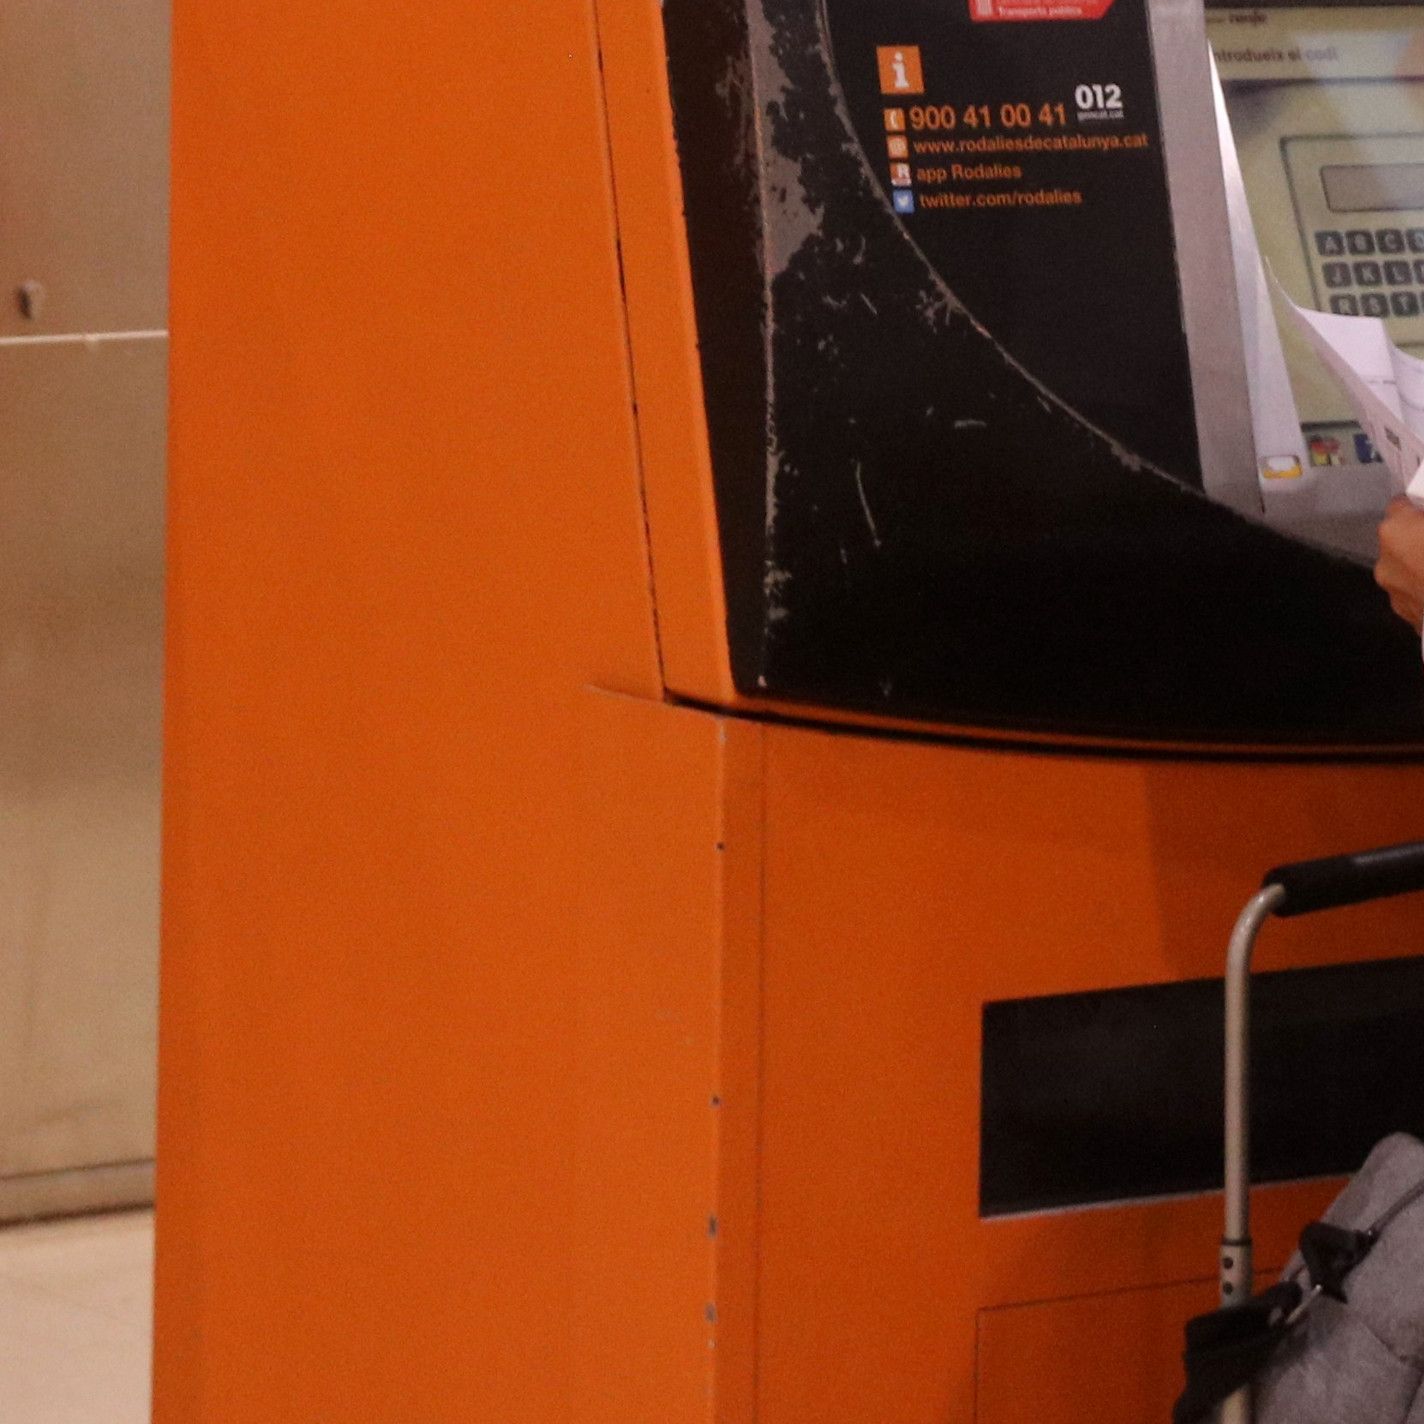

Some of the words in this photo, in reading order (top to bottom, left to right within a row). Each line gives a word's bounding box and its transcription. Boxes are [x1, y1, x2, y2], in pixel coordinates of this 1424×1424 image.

[1214, 48, 1283, 62] ntrodueix
[1075, 84, 1123, 109] 012
[909, 105, 956, 129] 900
[963, 105, 992, 128] 41
[1001, 104, 1031, 127] 00
[1038, 103, 1067, 126] 41
[914, 133, 1149, 153] www.rodaliesdecatalunya.cat
[917, 168, 947, 184] app
[952, 163, 1023, 180] Rodalies
[920, 189, 1083, 208] twitter.com/rodalies
